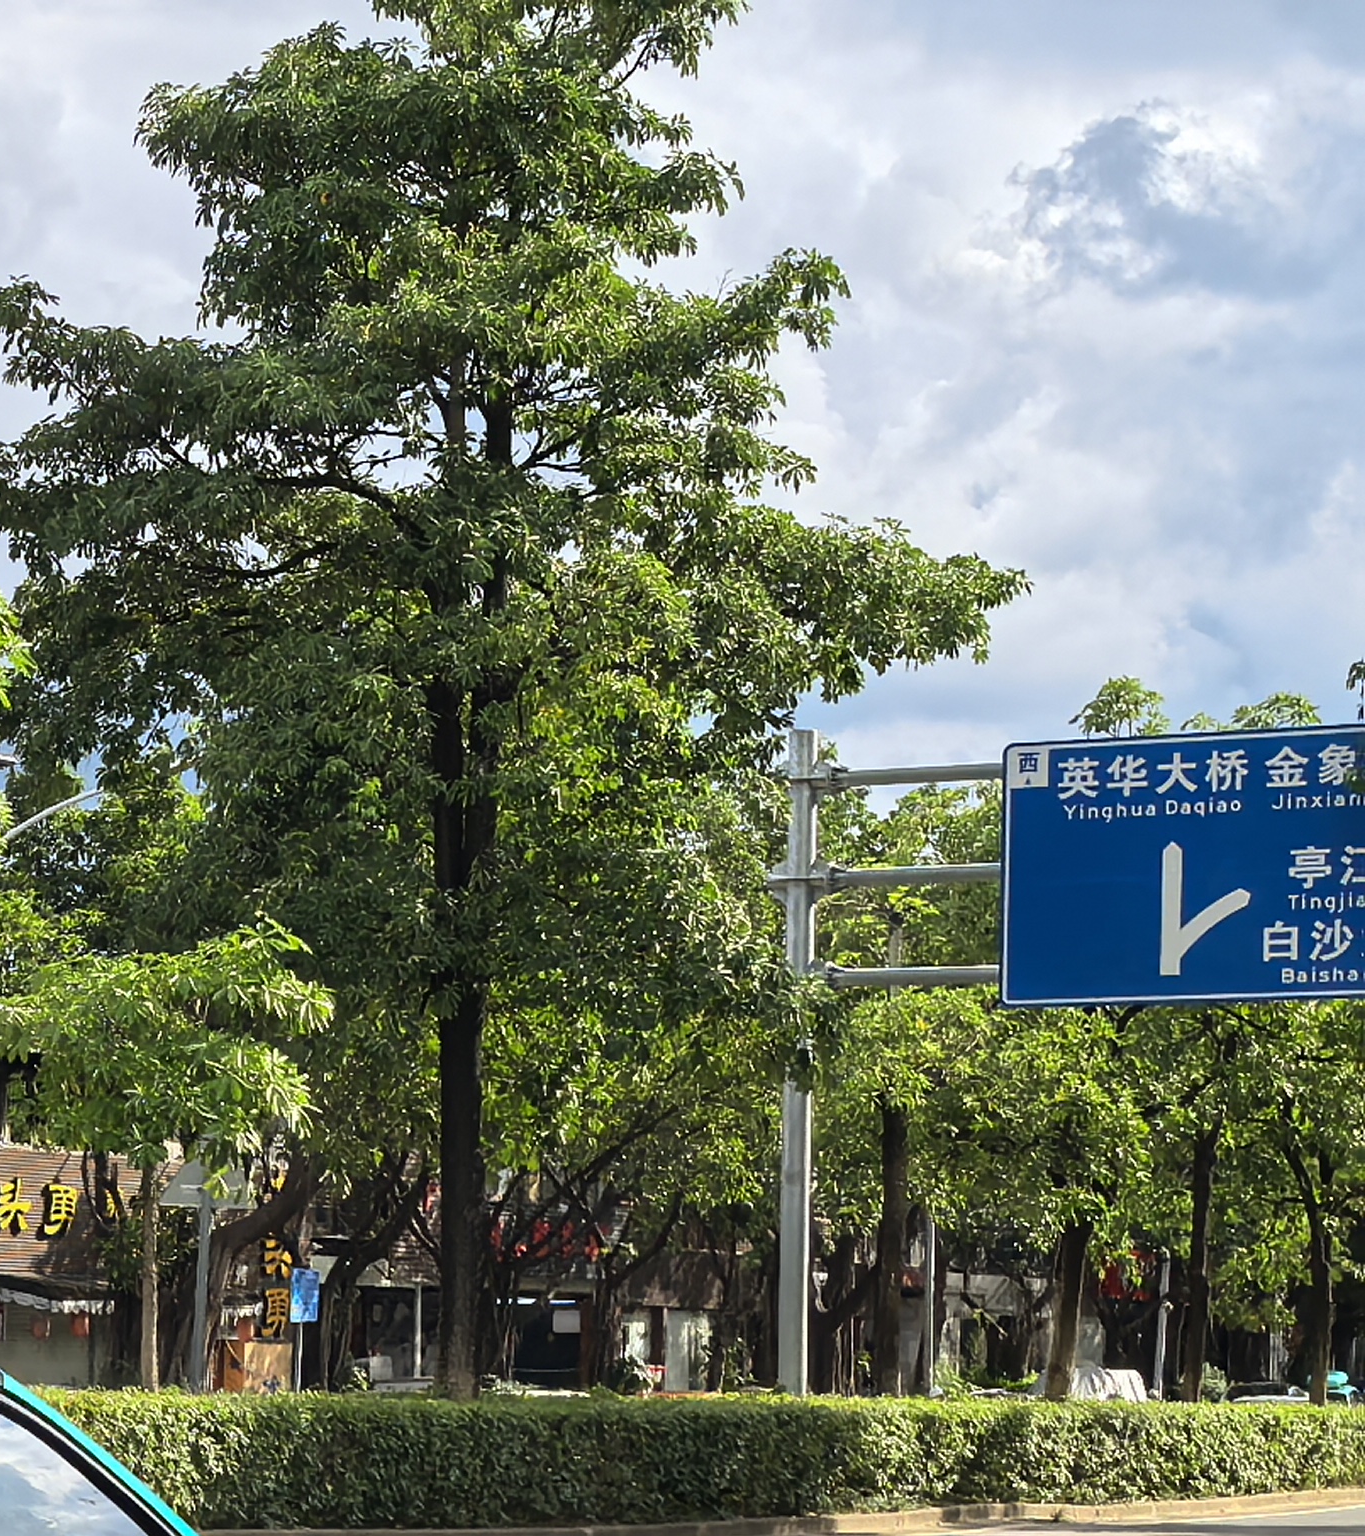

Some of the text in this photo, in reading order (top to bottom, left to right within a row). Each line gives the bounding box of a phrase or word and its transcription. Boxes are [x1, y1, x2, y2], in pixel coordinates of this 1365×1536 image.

[1018, 752, 1041, 774] 西
[1057, 749, 1250, 800] 英华大桥
[1063, 803, 1157, 823] Yinghua
[1165, 797, 1243, 817] Daqiao
[1262, 918, 1365, 962] 白沙
